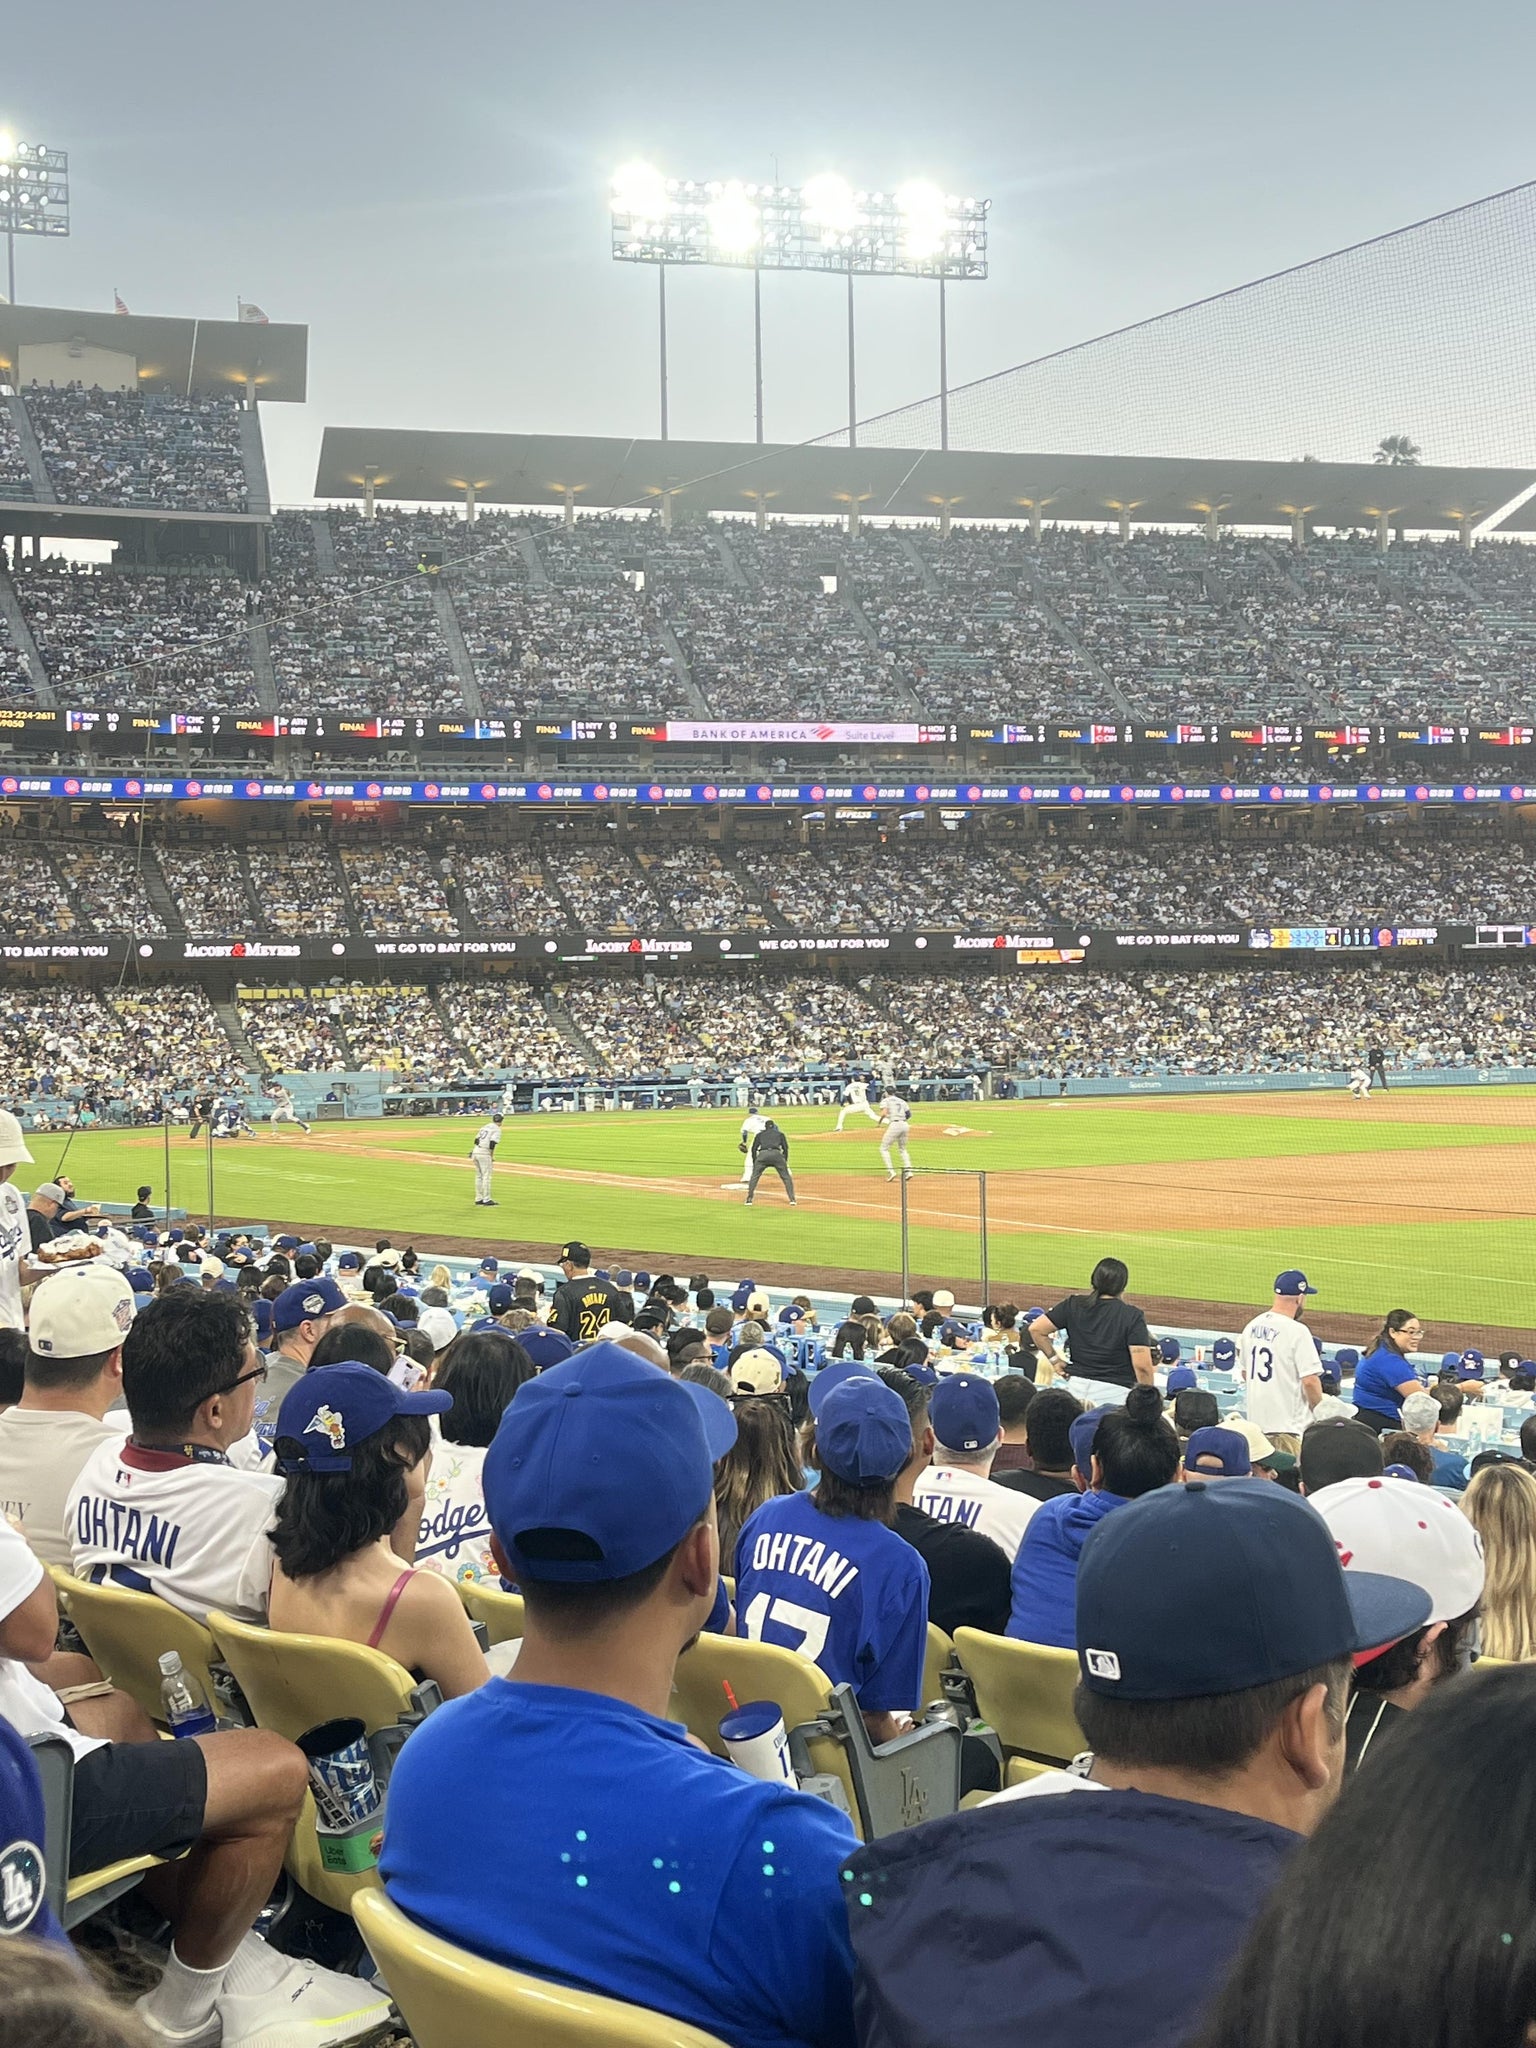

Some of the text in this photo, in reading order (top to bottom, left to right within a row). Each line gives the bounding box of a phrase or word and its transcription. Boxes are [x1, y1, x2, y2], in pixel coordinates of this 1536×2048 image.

[82, 712, 119, 722] TOR 10
[186, 716, 205, 724] CHC
[82, 723, 93, 731] SF
[132, 719, 160, 728] FINAL
[236, 721, 263, 730] FINAL
[340, 723, 366, 731] FINAL
[439, 724, 465, 733] FINAL
[186, 725, 203, 734] BAL
[536, 725, 562, 734] FINAL
[631, 727, 656, 735] FINAL
[693, 730, 807, 739] BANK OF AMERICA
[970, 729, 994, 738] FINAL
[1058, 730, 1081, 738] FINAL
[1145, 730, 1168, 739] FINAL
[1230, 730, 1253, 739] FINAL
[845, 730, 895, 740] Suite Level
[1314, 731, 1337, 739] FINAL
[1479, 732, 1501, 740] FINAL
[759, 939, 890, 949] WE GO TO BAT FOR YOU
[1116, 936, 1136, 945] WE
[1137, 936, 1153, 945] GO
[1154, 936, 1170, 945] TO
[1171, 935, 1192, 944] BAT
[1193, 935, 1216, 944] FOR
[1217, 935, 1240, 944] YOU
[4, 946, 108, 957] TO BAT FOR YOU
[375, 943, 516, 953] WE GO TO BAT FOR YOU
[579, 1308, 610, 1341] 24
[1251, 1325, 1280, 1343] MUNCY
[1251, 1346, 1273, 1382] 13
[912, 1495, 983, 1530] TANI
[78, 1496, 181, 1570] OHTANI
[418, 1498, 487, 1559] odge
[753, 1533, 859, 1599] OHTANI
[745, 1592, 831, 1662] 17
[325, 1845, 344, 1856] Uber
[327, 1855, 347, 1866] Eats
[2, 1862, 33, 1921] LA
